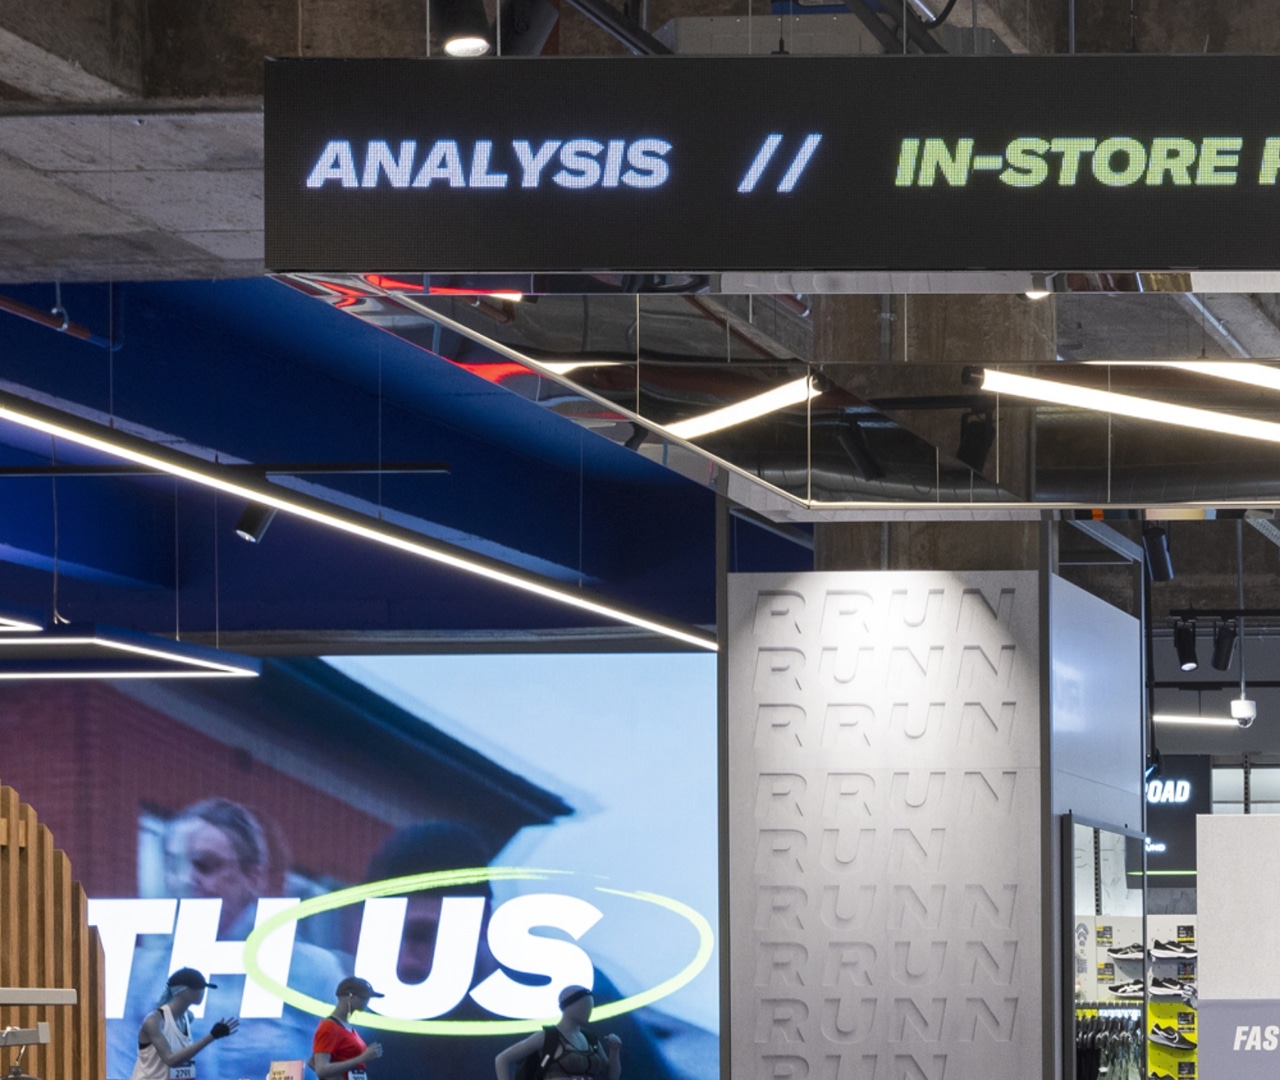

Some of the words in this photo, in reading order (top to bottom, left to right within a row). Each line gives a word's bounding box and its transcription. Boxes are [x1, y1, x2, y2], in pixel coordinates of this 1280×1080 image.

[306, 138, 672, 189] ANALYSIS
[894, 136, 1244, 187] IN-STORE
[1145, 780, 1191, 803] OAD
[354, 893, 604, 1022] US
